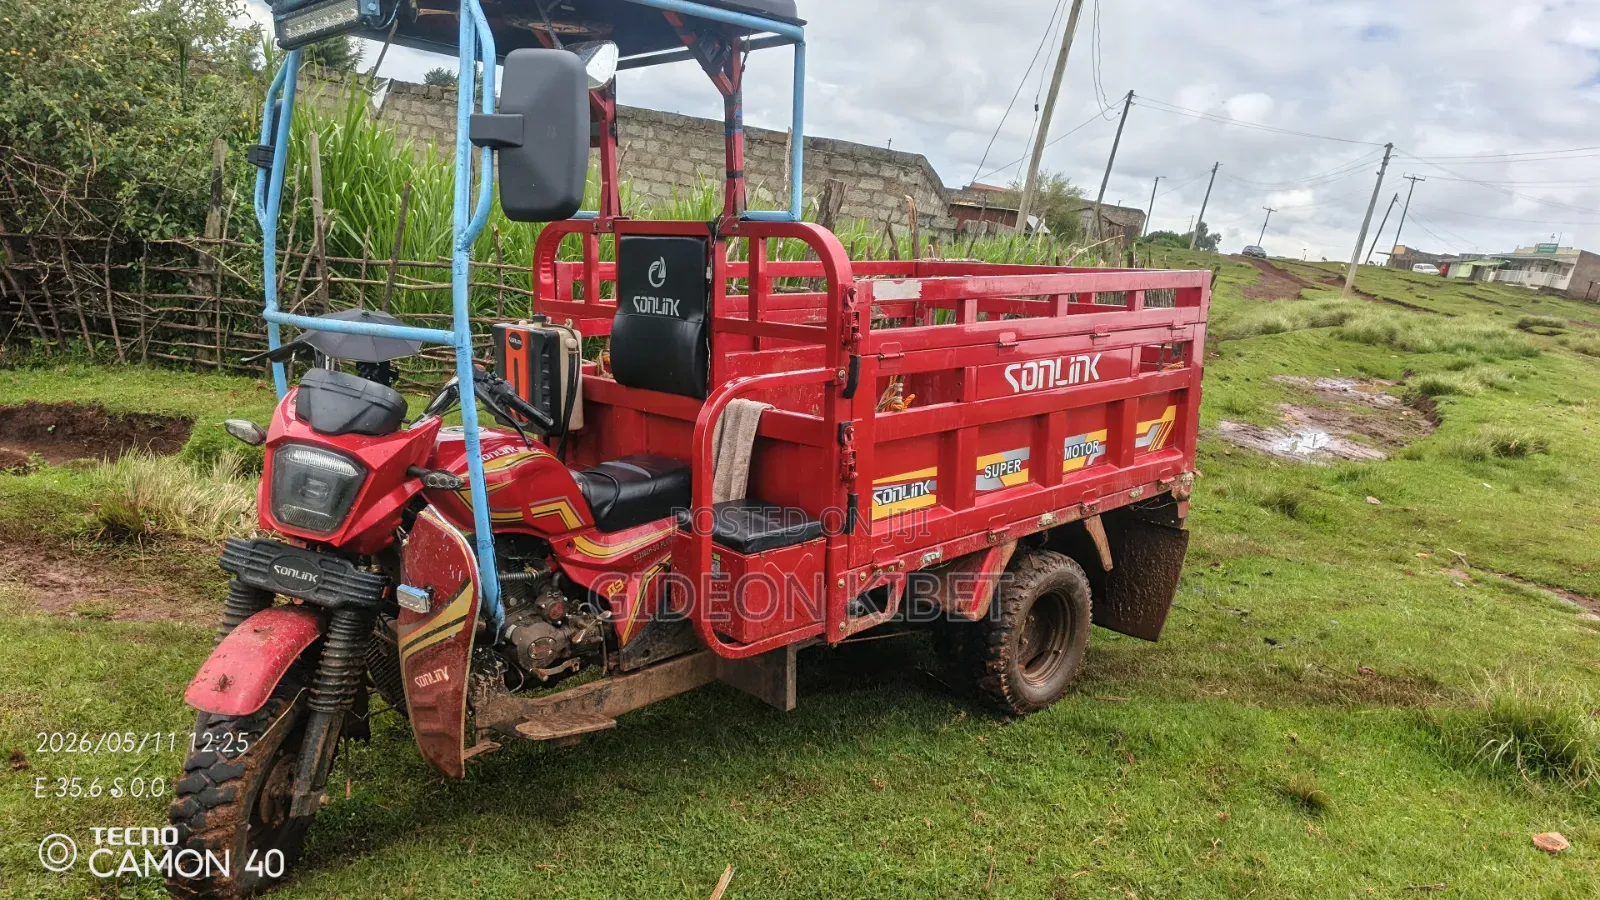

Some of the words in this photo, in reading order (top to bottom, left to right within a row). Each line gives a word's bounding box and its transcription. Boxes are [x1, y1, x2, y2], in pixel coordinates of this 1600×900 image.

[1004, 353, 1102, 393] SONLINK
[872, 479, 930, 506] SONLINK
[984, 459, 1021, 479] SUPER
[1063, 440, 1099, 460] MOTOR
[273, 564, 318, 583] SONLINK
